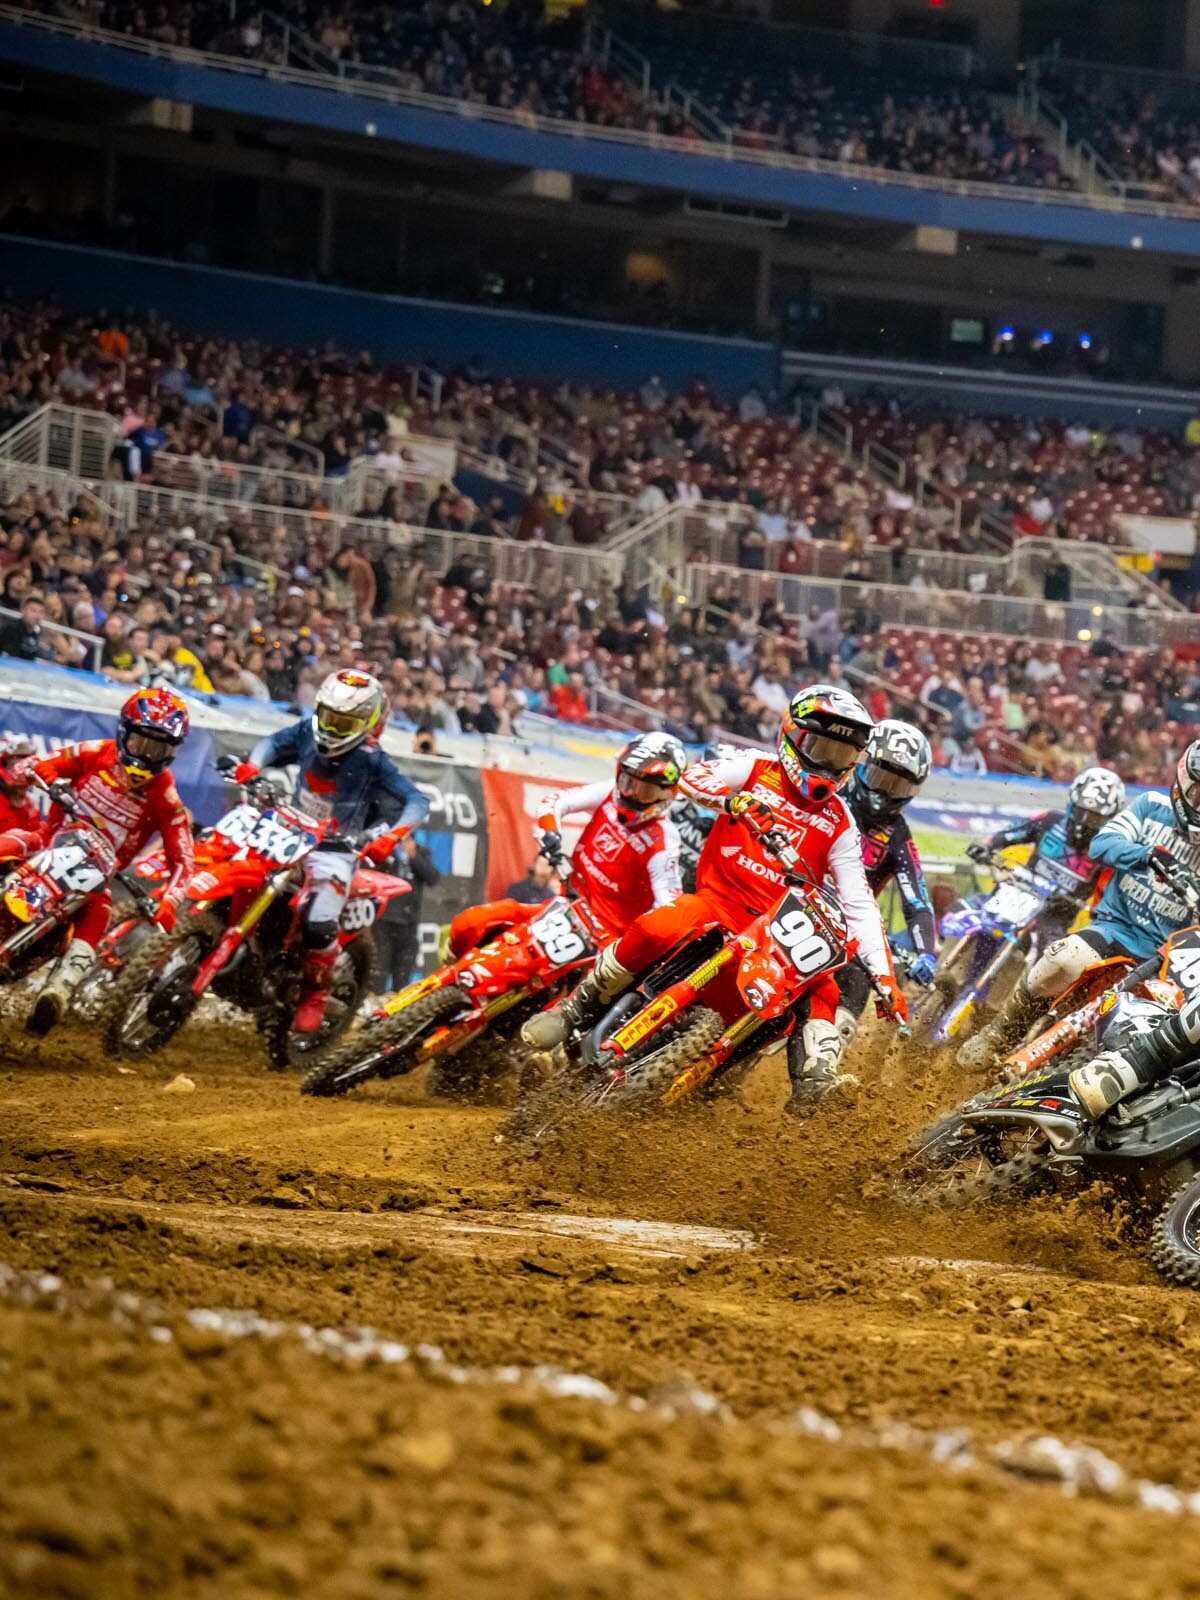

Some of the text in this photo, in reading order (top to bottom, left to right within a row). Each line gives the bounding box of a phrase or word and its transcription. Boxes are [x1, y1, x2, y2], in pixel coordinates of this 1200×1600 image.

[736, 853, 788, 888] HON
[531, 911, 585, 964] 39
[770, 910, 832, 974] 90
